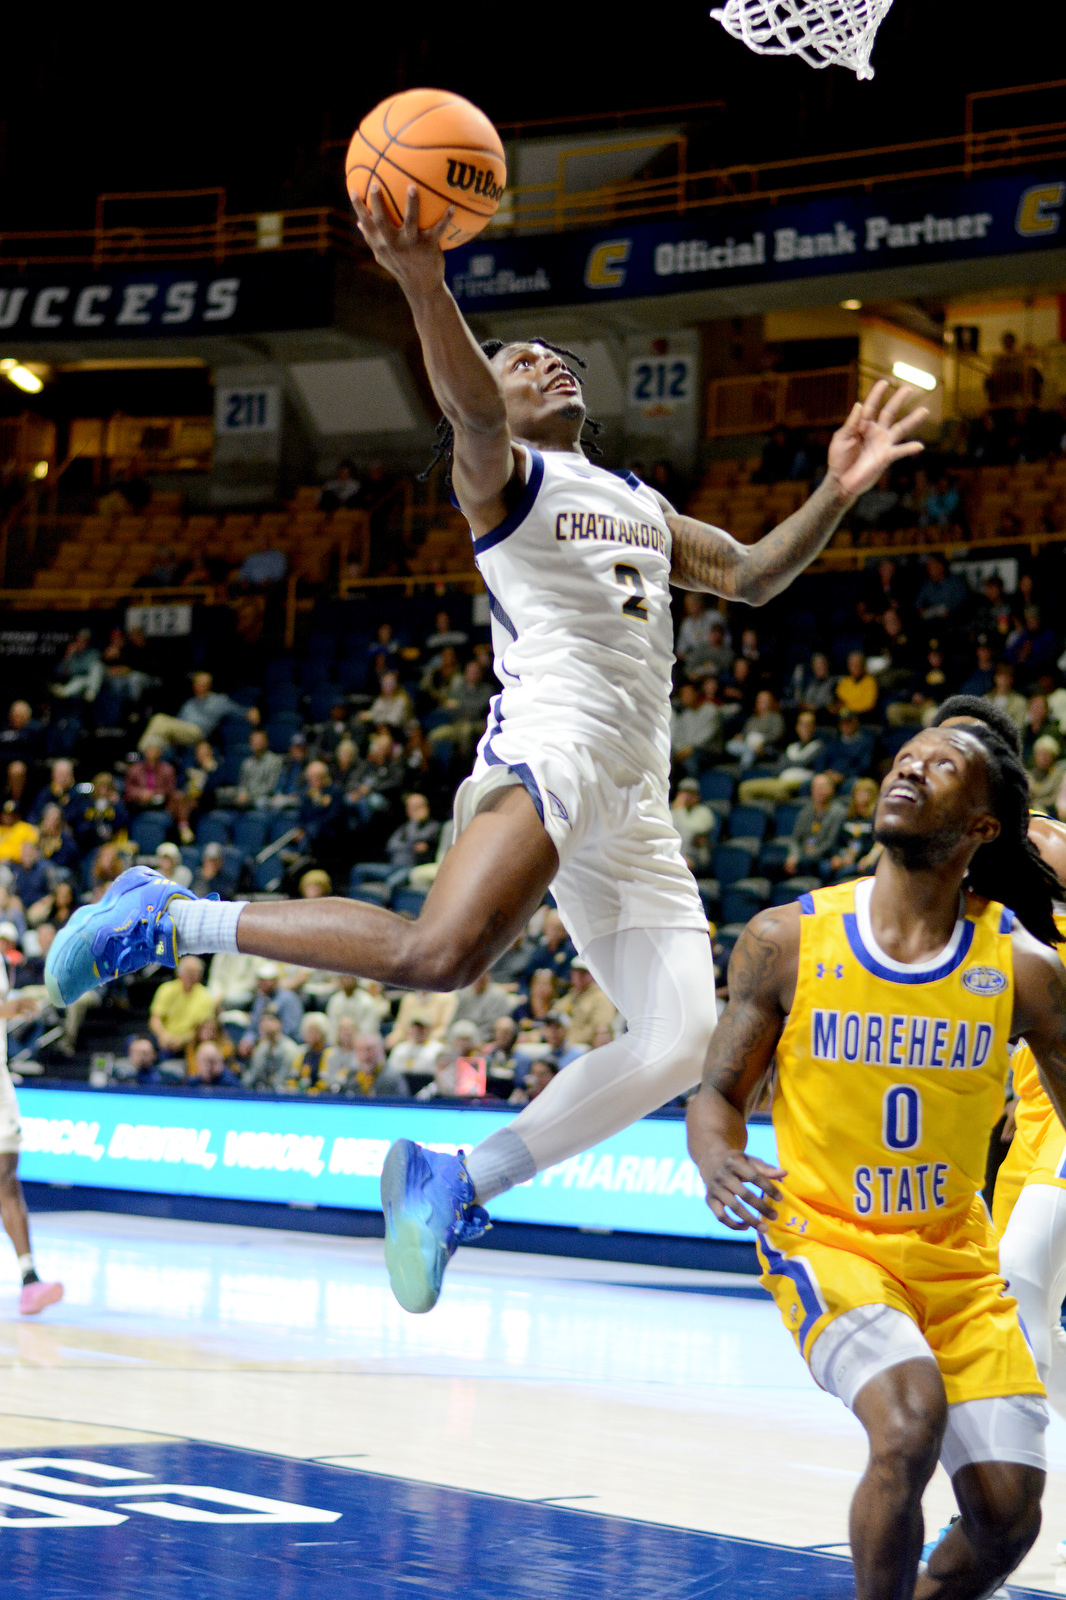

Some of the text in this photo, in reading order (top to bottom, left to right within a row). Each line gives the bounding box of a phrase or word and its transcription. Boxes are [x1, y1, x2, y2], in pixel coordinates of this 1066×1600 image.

[654, 213, 993, 276] Official Bank Partner
[226, 393, 267, 428] 211
[635, 362, 687, 399] 212
[614, 562, 649, 623] 2
[811, 1008, 995, 1070] MOREHEAD
[882, 1083, 922, 1151] 0
[853, 1161, 951, 1214] STATE
